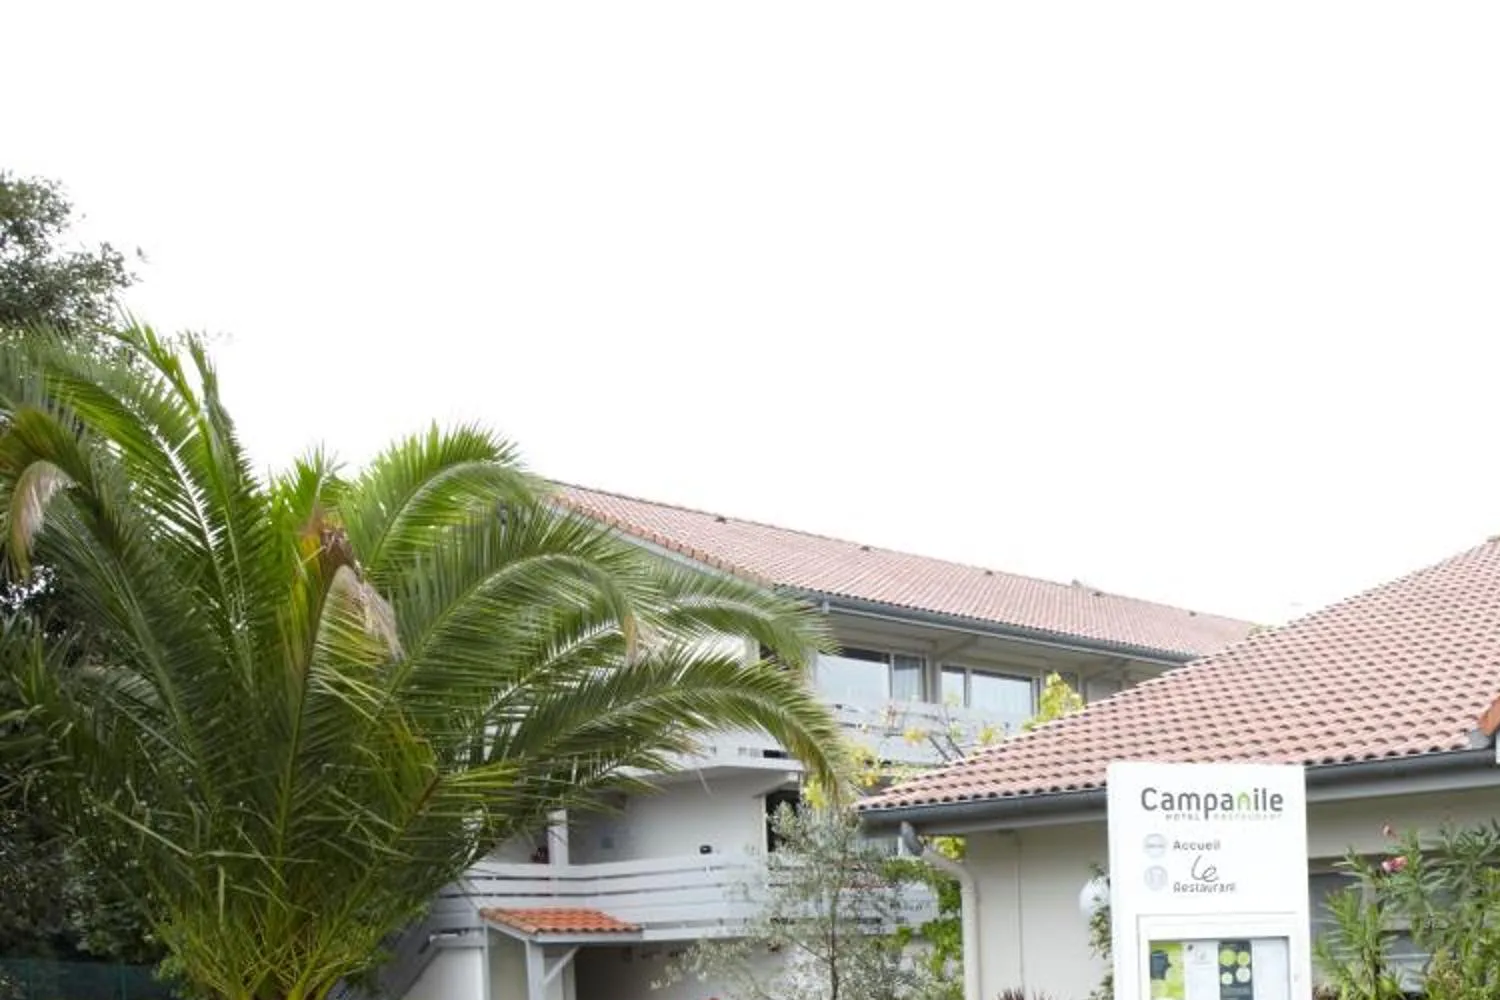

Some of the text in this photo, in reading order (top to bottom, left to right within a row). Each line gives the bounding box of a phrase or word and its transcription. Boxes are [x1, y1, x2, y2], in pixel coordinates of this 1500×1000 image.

[1141, 787, 1284, 820] Campanile
[1173, 840, 1221, 851] Accueil
[1173, 882, 1236, 893] Restaurant
